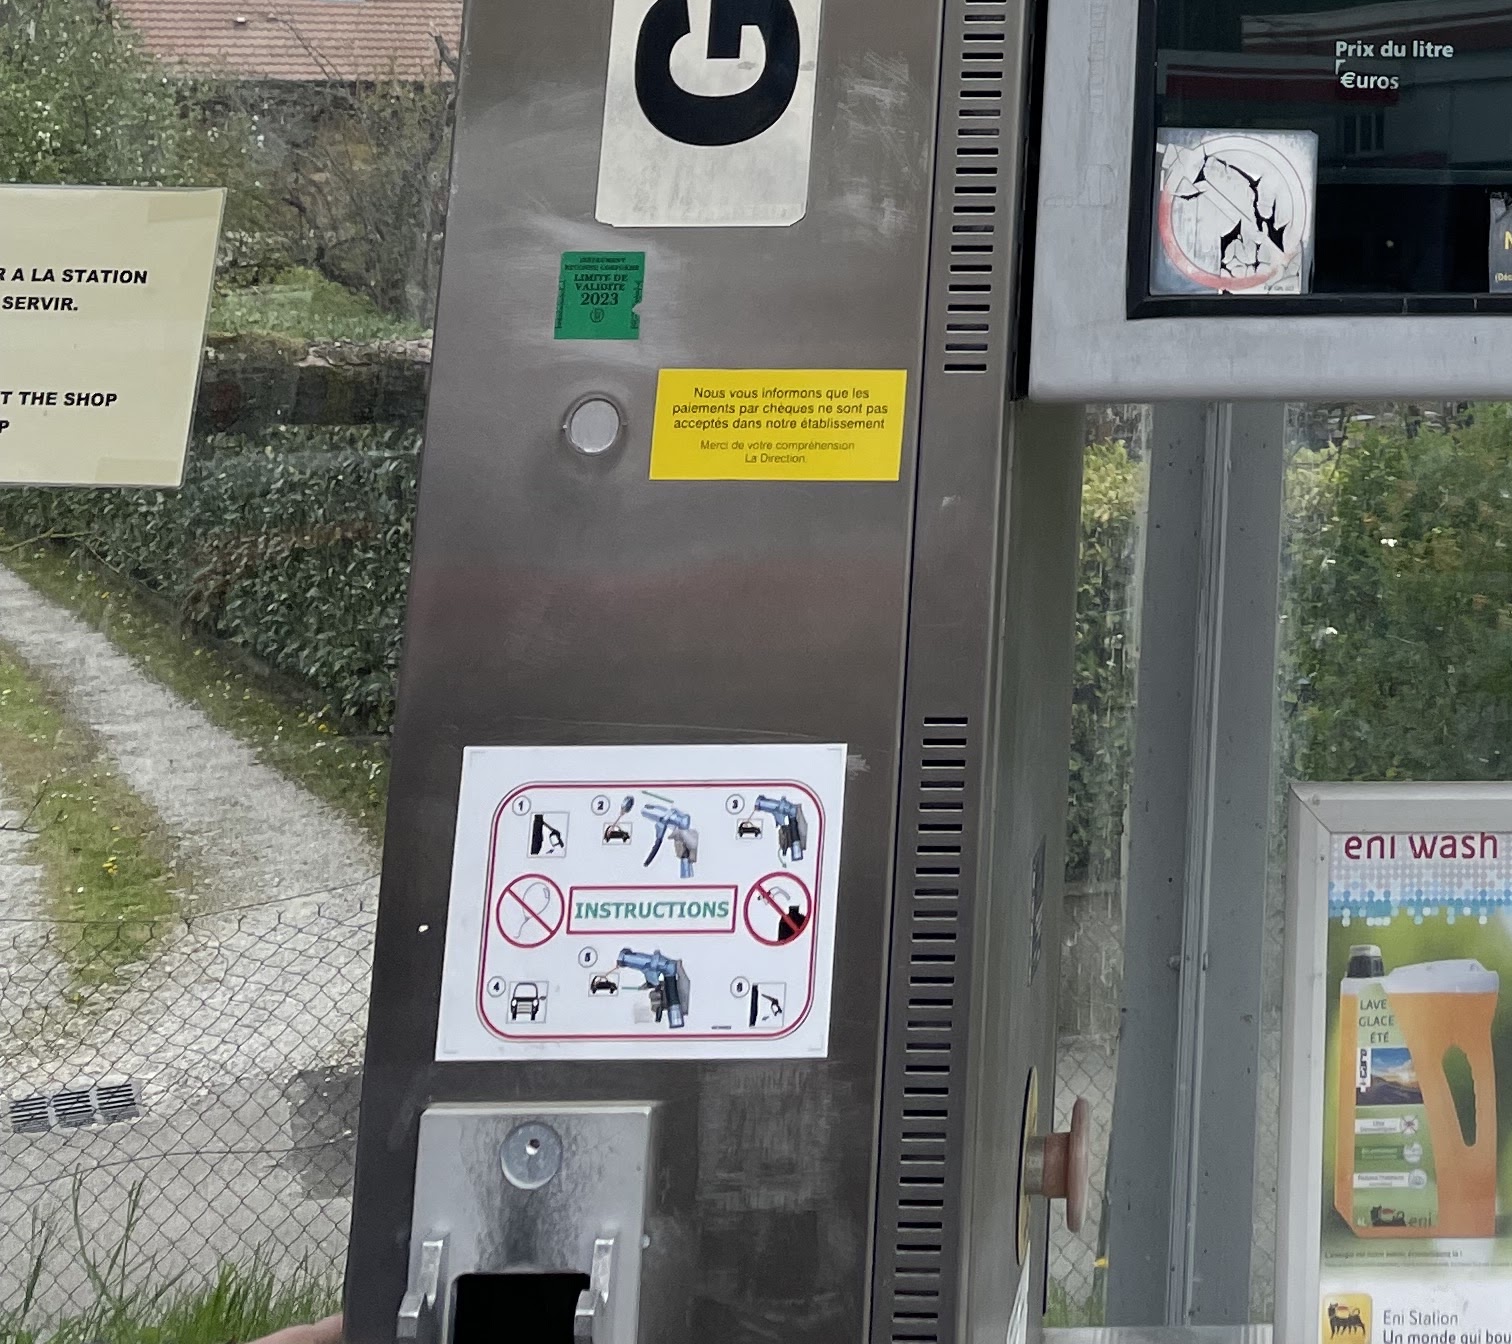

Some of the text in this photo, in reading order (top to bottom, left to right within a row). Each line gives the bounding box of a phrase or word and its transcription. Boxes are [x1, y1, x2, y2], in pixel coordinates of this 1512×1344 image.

[1335, 40, 1454, 58] Prix du litre
[1340, 72, 1400, 90] €uros
[11, 268, 24, 282] A
[31, 268, 56, 282] LA
[62, 268, 148, 284] STATION
[574, 274, 612, 282] LIMITE
[2, 296, 78, 311] SERVIR.
[580, 292, 619, 306] 2023
[18, 392, 58, 406] THE
[64, 392, 118, 407] SHOP
[694, 387, 870, 401] Nous vous informons que les
[672, 403, 736, 415] paiements
[739, 405, 759, 415] par
[818, 405, 832, 414] ne
[836, 404, 862, 414] sont
[866, 405, 888, 416] pas
[674, 418, 885, 431] acceptés dans notre établissement
[700, 440, 855, 452] Merci de votre compréhension
[744, 454, 757, 464] La
[1344, 832, 1498, 860] eni wash
[574, 900, 730, 920] INSTRUCTIONS
[1360, 999, 1387, 1010] LAVE
[1358, 1015, 1394, 1027] GLACE
[1370, 1031, 1390, 1044] ÉTÉ
[1383, 1310, 1458, 1326] Eni Station
[1383, 1330, 1403, 1344] Un
[1407, 1330, 1456, 1344] monde
[1460, 1330, 1482, 1344] qui
